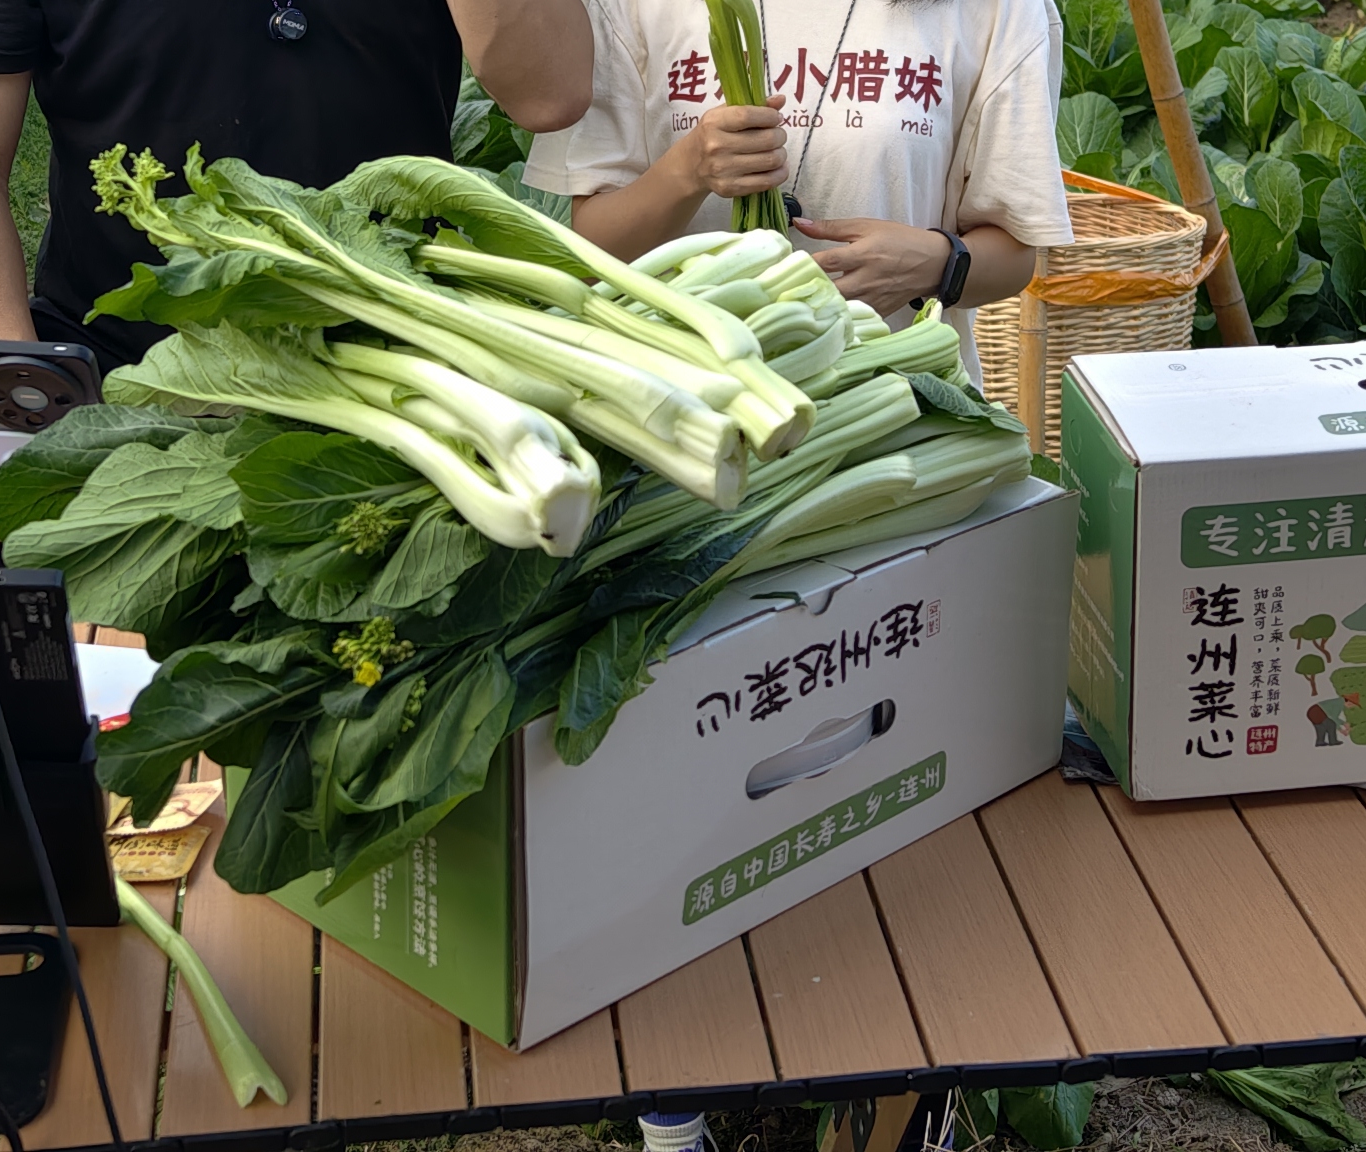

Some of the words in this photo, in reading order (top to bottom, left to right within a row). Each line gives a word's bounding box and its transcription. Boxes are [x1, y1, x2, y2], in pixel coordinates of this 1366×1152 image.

[668, 47, 943, 114] 连小腊妹
[846, 110, 863, 128] là
[901, 118, 933, 137] mèi
[1186, 583, 1245, 758] 连州菜心
